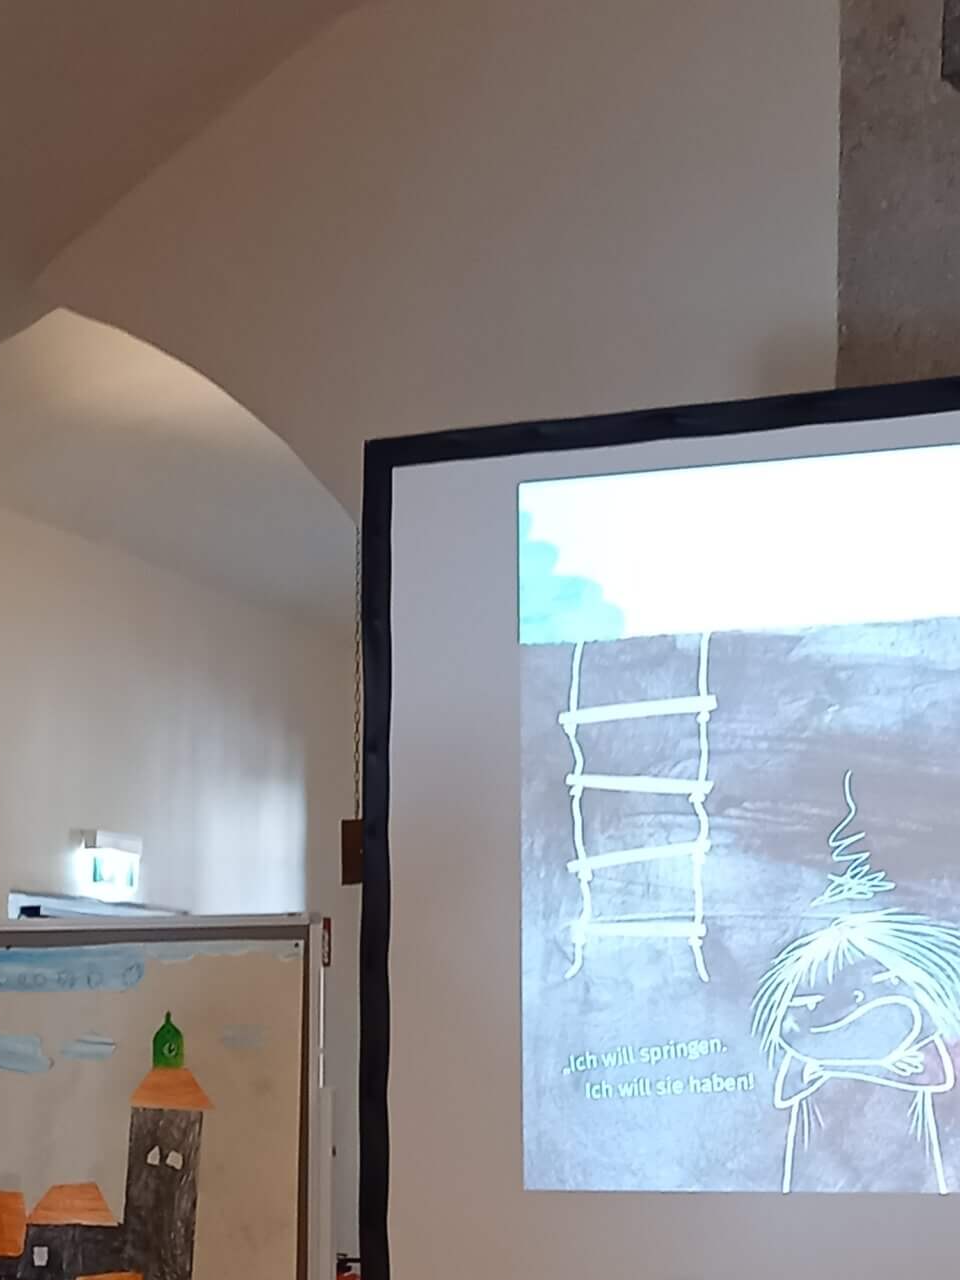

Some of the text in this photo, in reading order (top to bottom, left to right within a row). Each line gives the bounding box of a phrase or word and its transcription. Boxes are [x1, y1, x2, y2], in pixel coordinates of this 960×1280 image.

[602, 1046, 636, 1069] will
[585, 1079, 613, 1099] Ich
[618, 1078, 651, 1097] will
[655, 1076, 684, 1095] sie
